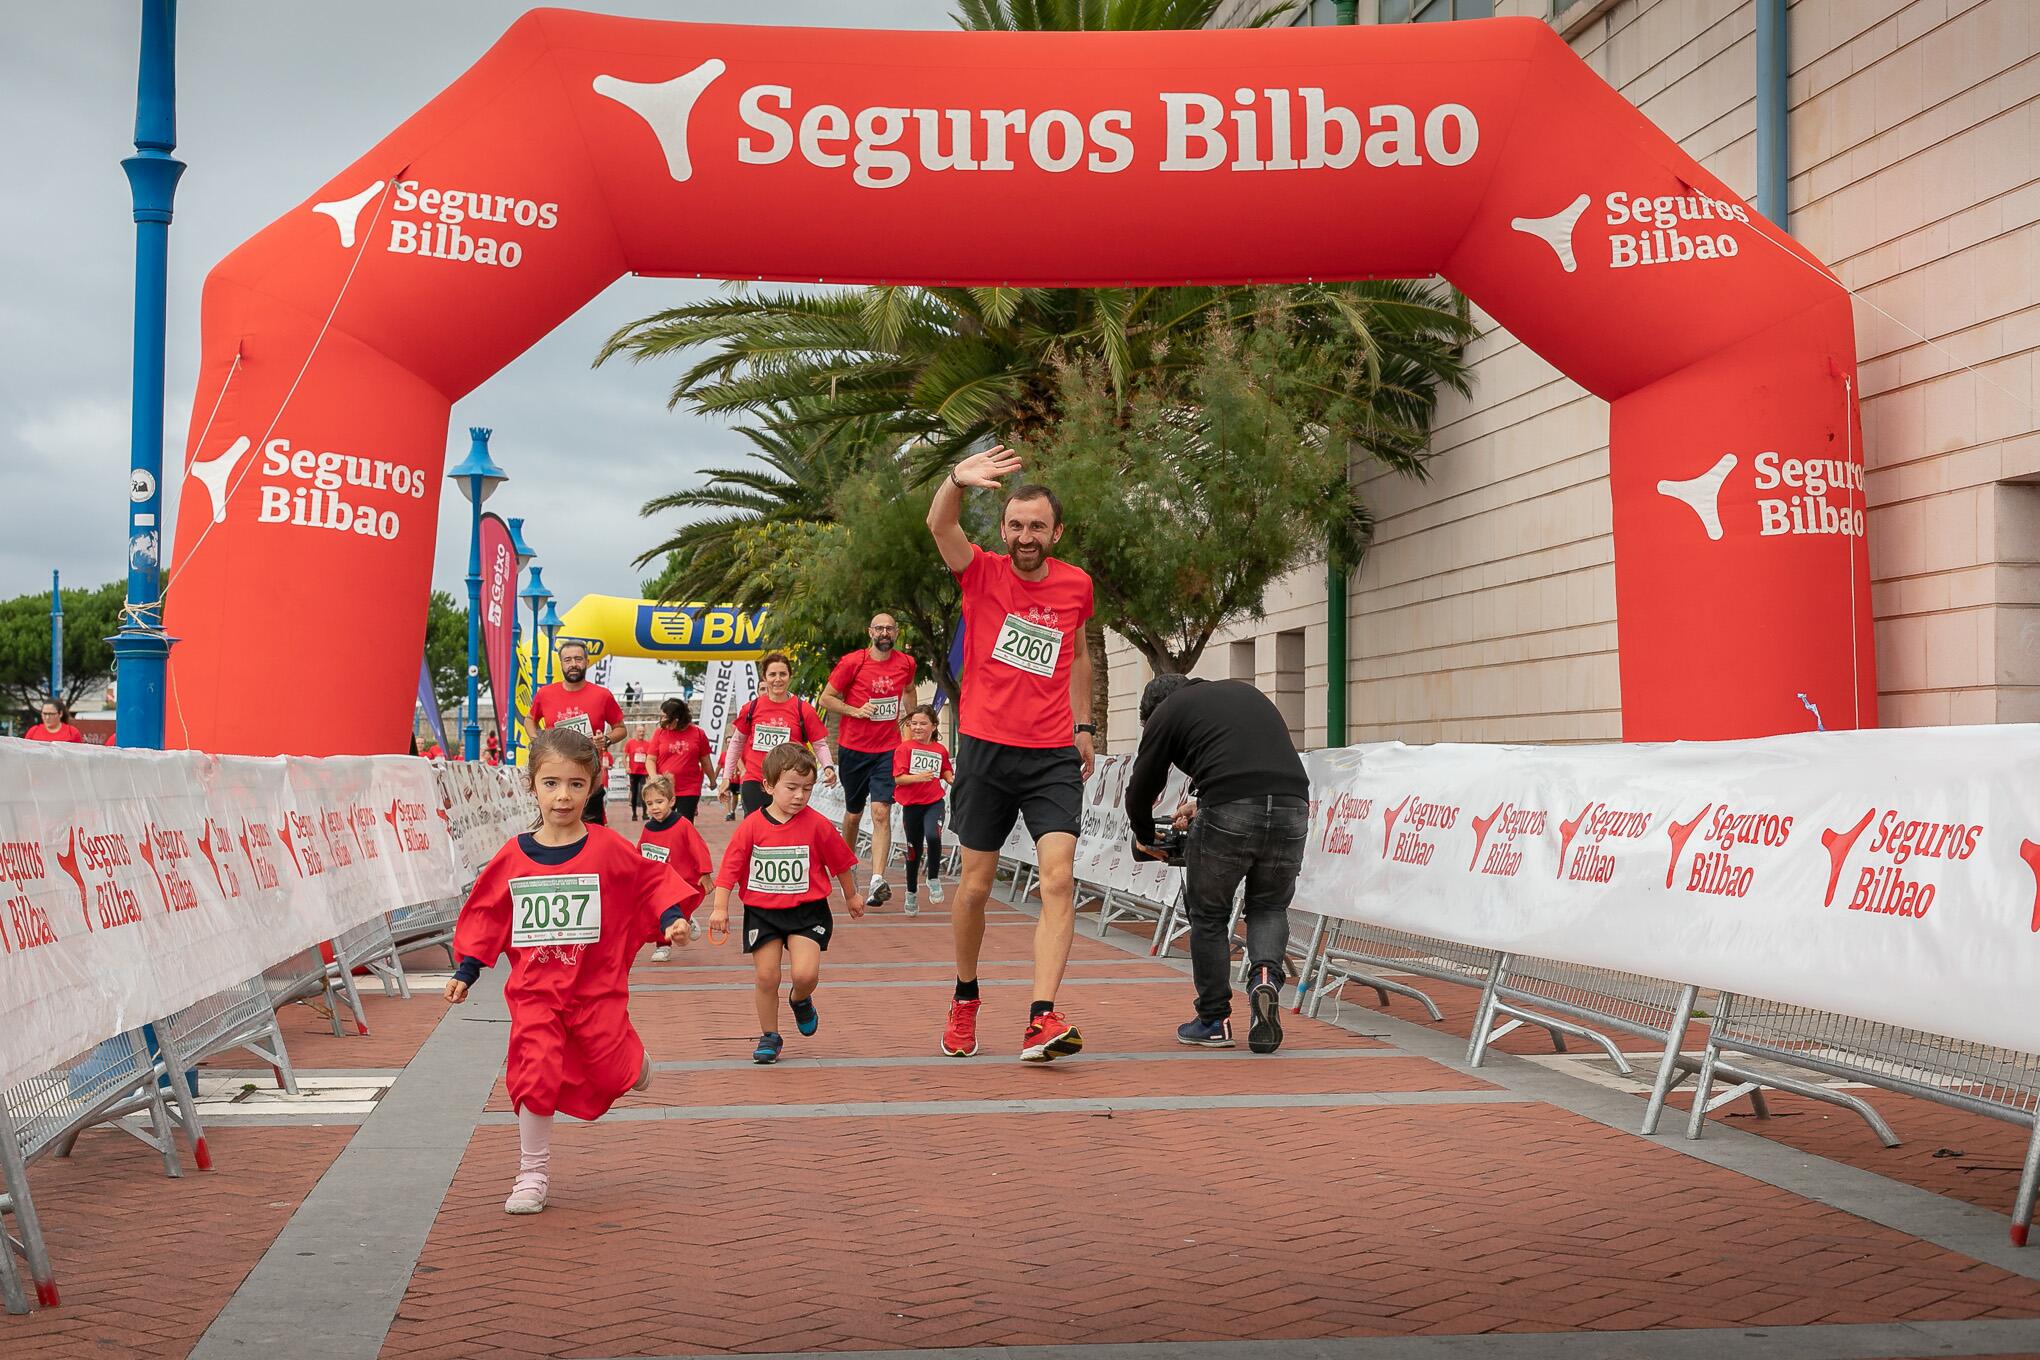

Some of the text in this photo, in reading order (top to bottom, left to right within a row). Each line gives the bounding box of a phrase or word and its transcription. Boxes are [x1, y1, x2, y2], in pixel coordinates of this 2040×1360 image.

[738, 85, 1479, 188] Seguros Bilbao
[393, 179, 558, 229] Seguros
[1605, 191, 1750, 229] Seguros
[387, 219, 522, 268] Bilbao
[1608, 229, 1739, 269] Bilbao
[263, 438, 425, 499] Seguros
[1754, 451, 1865, 496] Seguro
[257, 485, 400, 541] Bilbao
[1757, 495, 1864, 537] Bilbao
[491, 543, 506, 601] Getxo
[585, 640, 601, 654] M
[1001, 629, 1053, 665] 2060
[873, 702, 897, 716] 2043
[757, 732, 786, 746] 2037
[914, 756, 940, 772] 2043
[1403, 795, 1460, 832] Seguros
[1497, 802, 1548, 841] Seguros
[1585, 803, 1652, 843] Seguros
[1704, 804, 1794, 850] Seguros
[403, 828, 429, 851] Bilbao
[1392, 832, 1435, 866] Bilbao
[1869, 810, 1983, 864] Seguros
[754, 859, 804, 882] 2060
[1481, 843, 1523, 877] Bilbao
[1569, 846, 1616, 883] Bilbao
[1686, 853, 1755, 898] Bilbao
[521, 894, 590, 928] 2037
[1848, 866, 1936, 919] Bilbao
